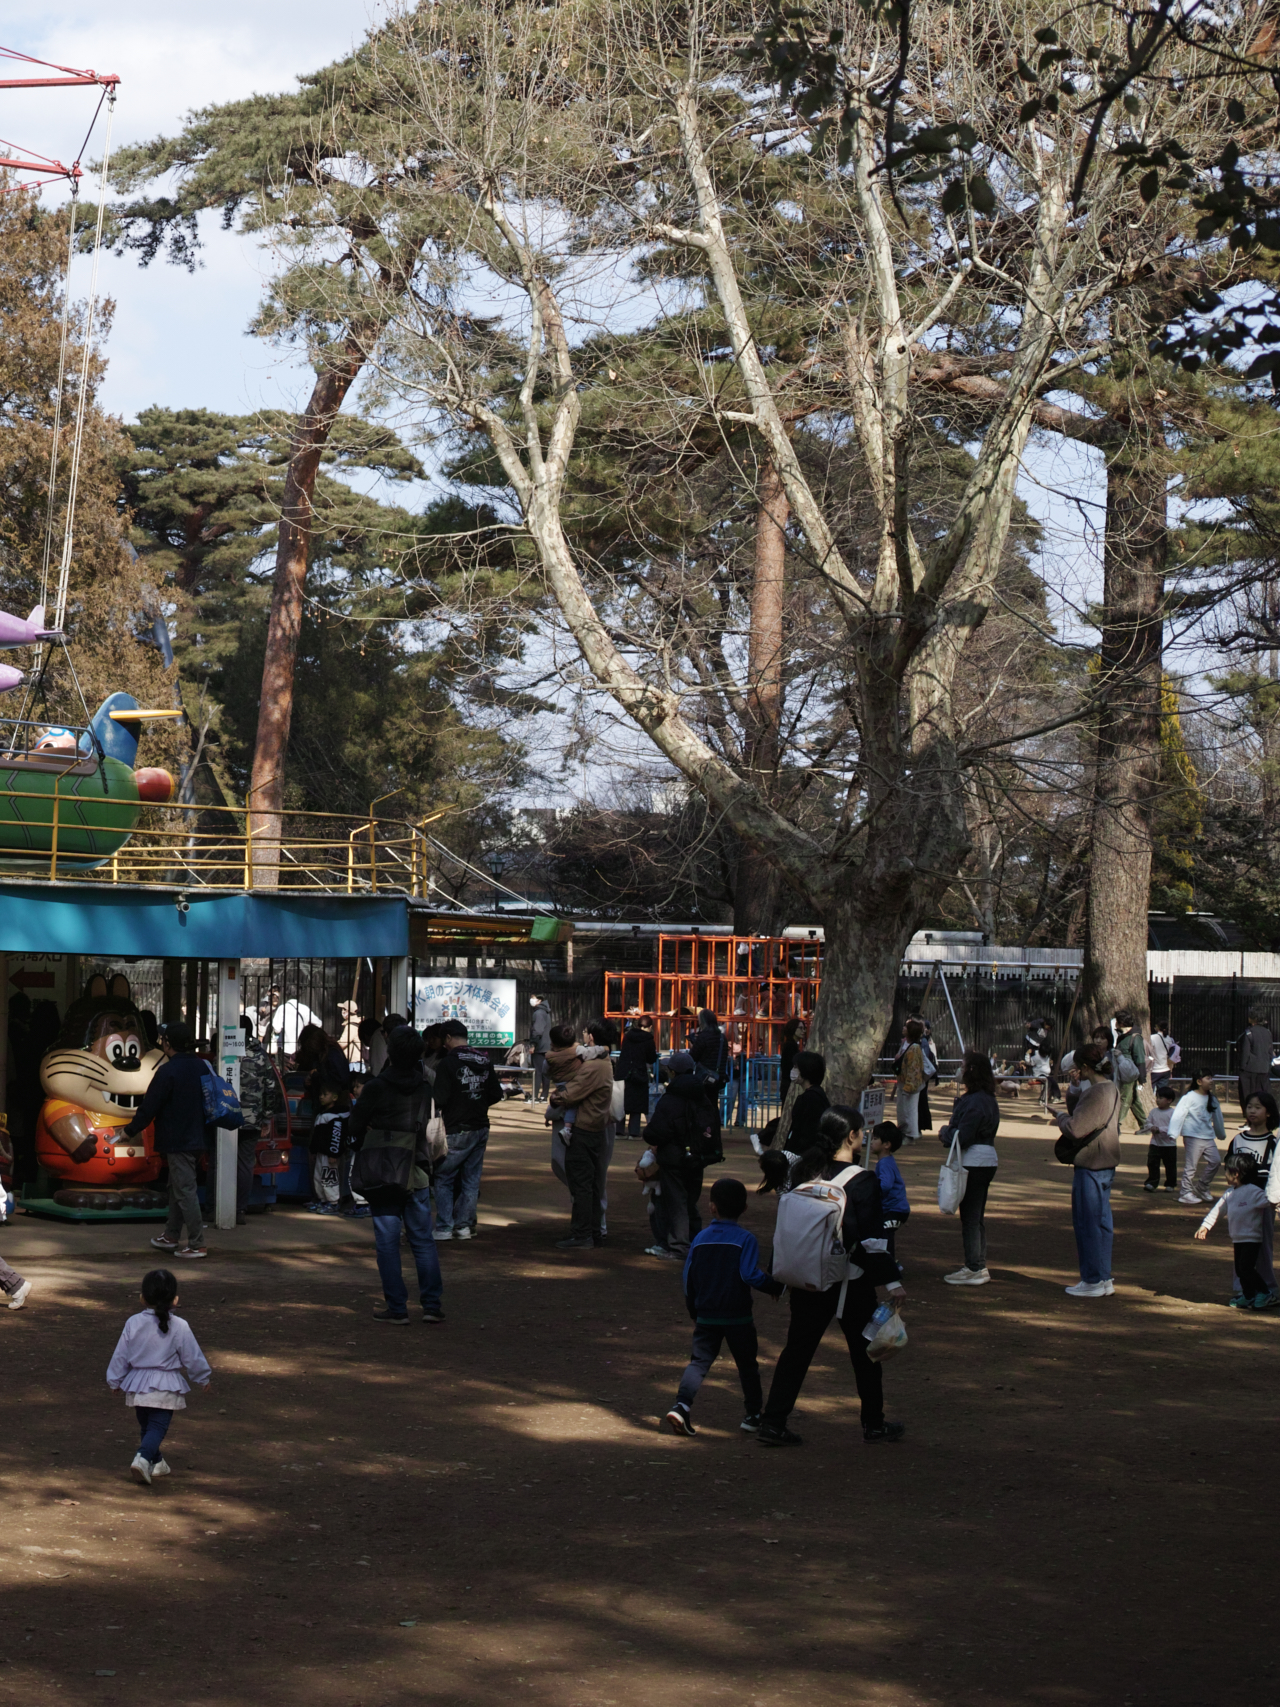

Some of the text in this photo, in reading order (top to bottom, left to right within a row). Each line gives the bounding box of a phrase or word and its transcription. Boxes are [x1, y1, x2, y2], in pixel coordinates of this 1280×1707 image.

[407, 981, 510, 1018] HK朝のラジオ体操会場
